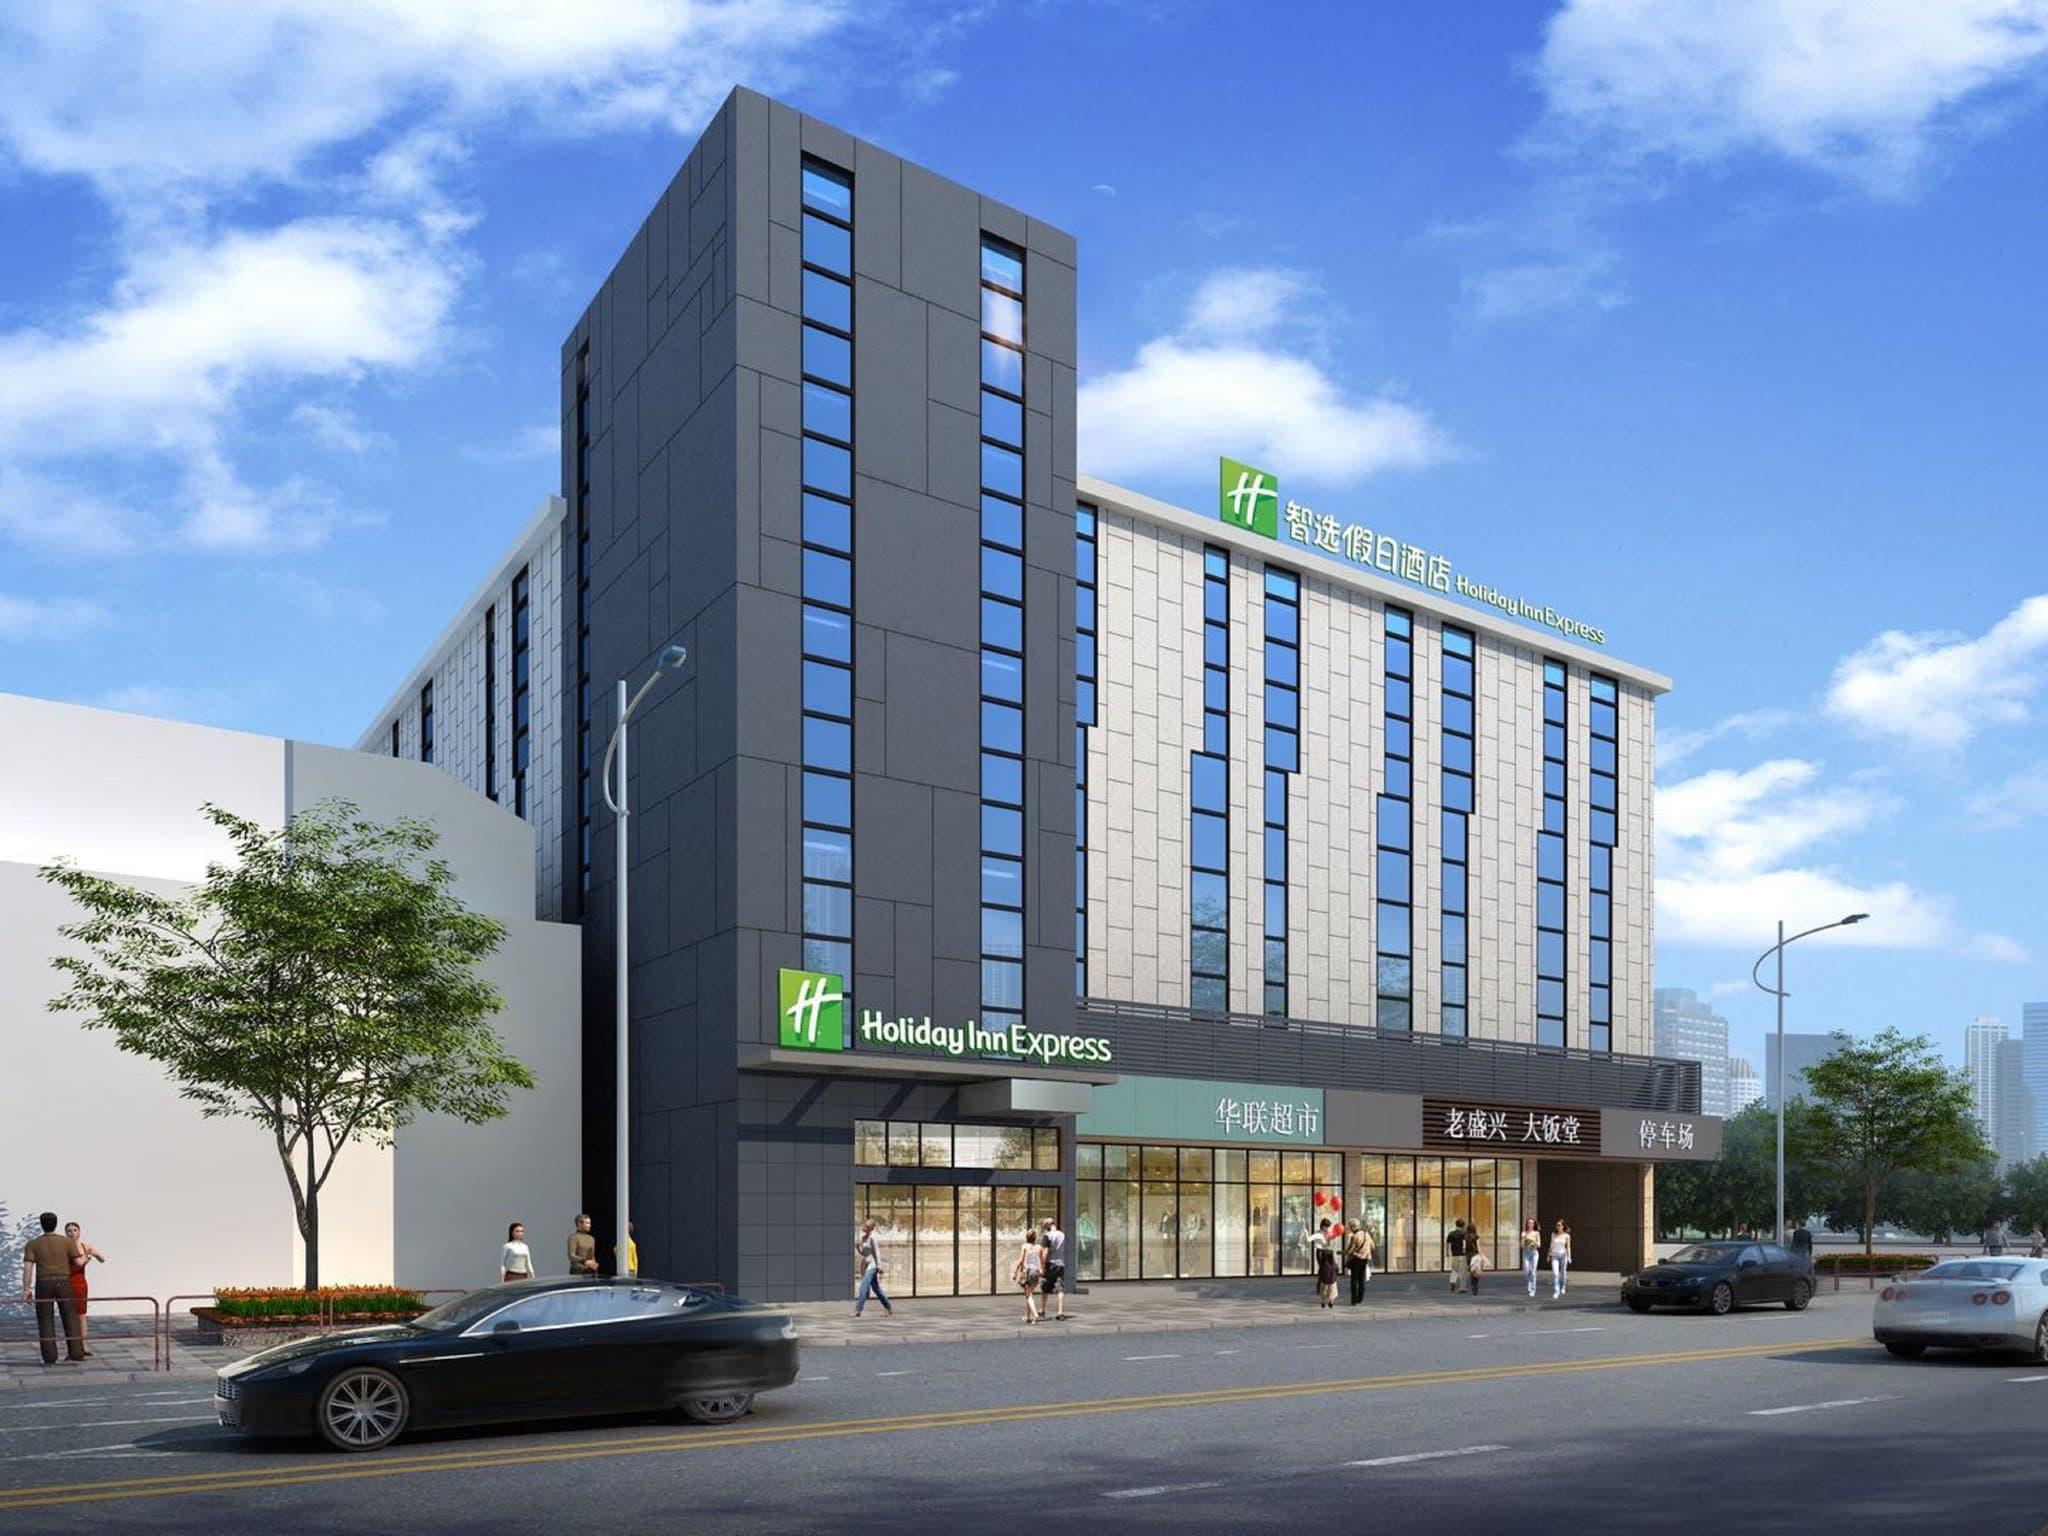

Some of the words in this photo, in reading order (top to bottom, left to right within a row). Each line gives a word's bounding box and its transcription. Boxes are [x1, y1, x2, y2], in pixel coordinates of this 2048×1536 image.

[1285, 500, 1452, 592] 智选假日酒店
[1455, 575, 1517, 616] Holiday
[1519, 598, 1543, 623] Inn
[1544, 607, 1606, 644] Express
[862, 1010, 964, 1052] Holiday
[968, 1021, 1007, 1053] Inn
[1011, 1025, 1113, 1065] Express
[1215, 1098, 1319, 1138] 华联超市
[1445, 1107, 1508, 1142] 老盛兴
[1522, 1111, 1582, 1145] 大饭堂
[1638, 1118, 1694, 1150] 停车场
